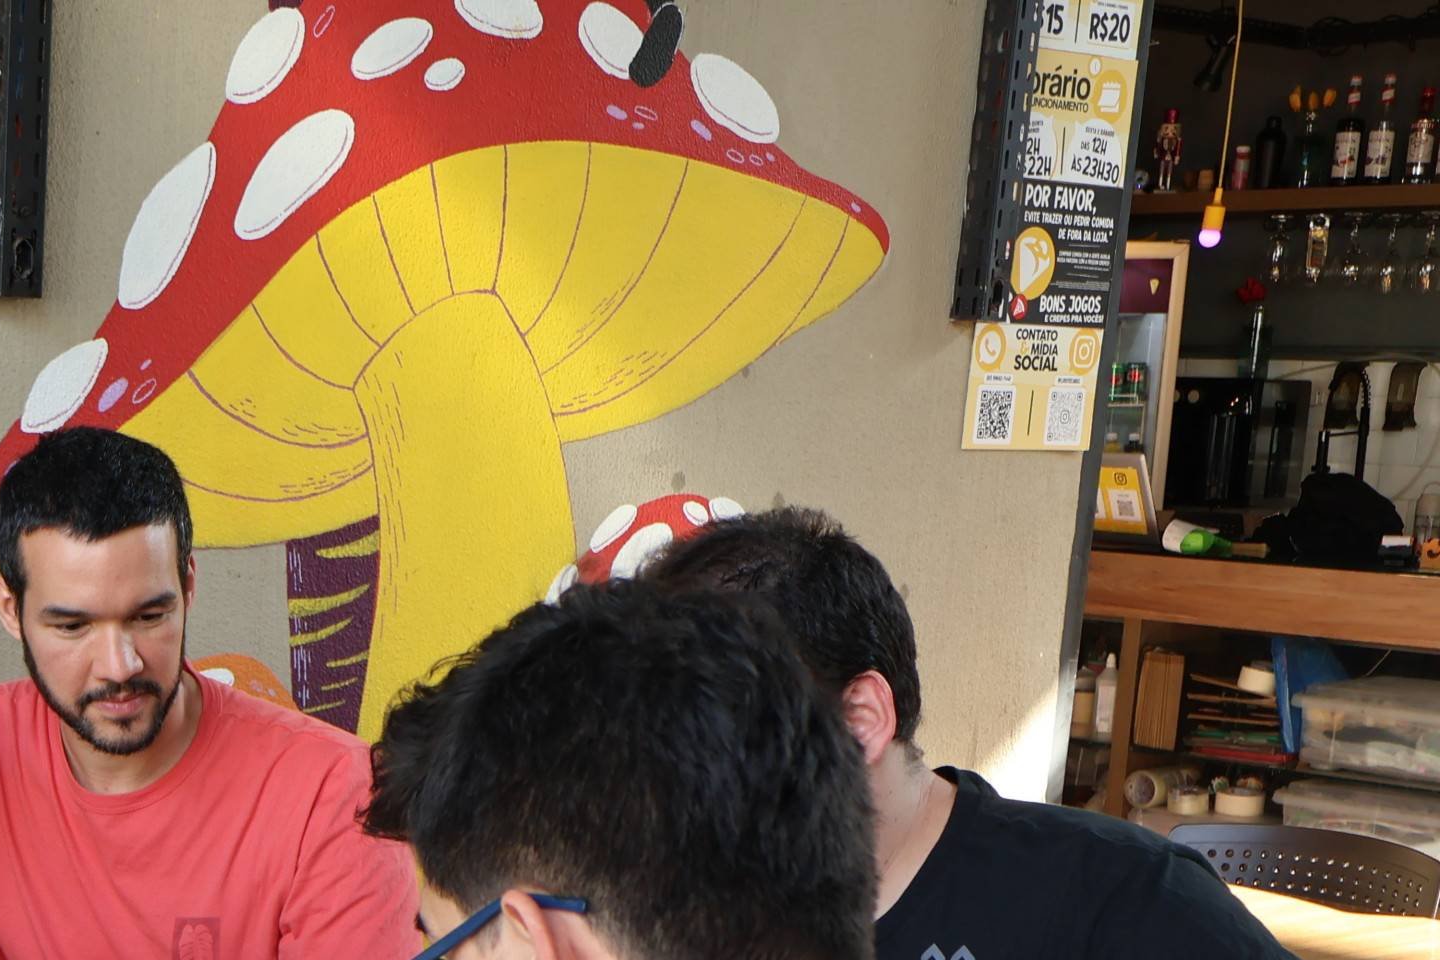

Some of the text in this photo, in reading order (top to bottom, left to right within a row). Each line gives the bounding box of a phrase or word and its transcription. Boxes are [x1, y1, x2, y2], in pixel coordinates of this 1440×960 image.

[1039, 3, 1065, 35] 15
[1089, 12, 1130, 43] R$20
[1032, 65, 1091, 100] orário
[1030, 96, 1089, 113] UNCIONAMENTO
[1081, 137, 1108, 155] DAS 12H
[1027, 156, 1052, 176] 22H
[1071, 153, 1120, 183] ÀS 23H30
[1024, 183, 1097, 215] POR FAVOR,
[1024, 210, 1114, 229] EVITE TRAZER OU PEDIR COMIDA
[1058, 228, 1066, 240] DE
[1067, 229, 1082, 241] FORA
[1083, 230, 1092, 242] DA
[1039, 294, 1102, 314] BONS JOGOS
[1044, 314, 1049, 323] E
[1071, 314, 1082, 323] PRA
[1016, 328, 1058, 341] CONTATO
[1031, 340, 1058, 356] MÍDIA
[1014, 354, 1058, 372] SOCIAL
